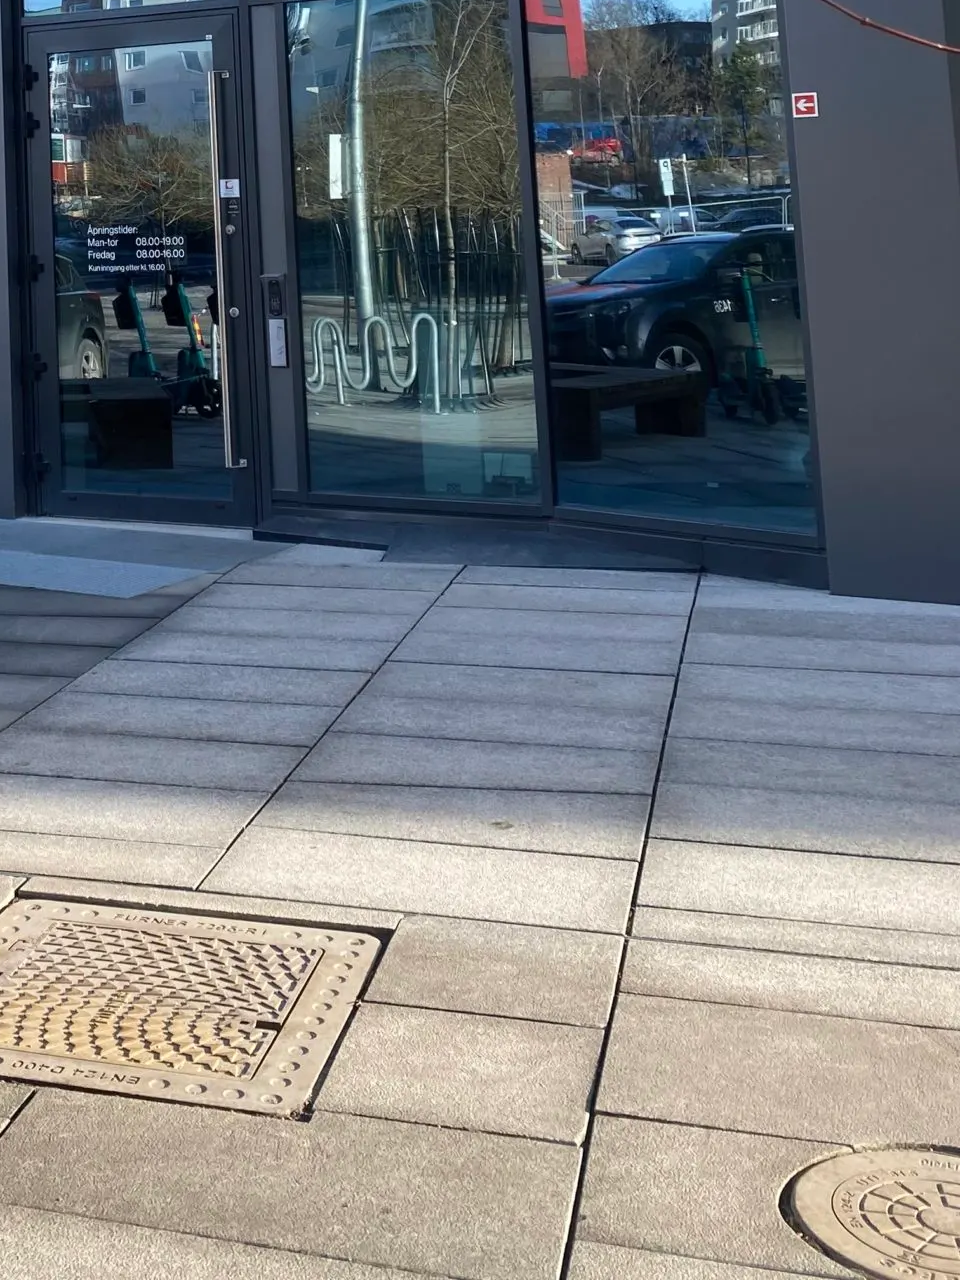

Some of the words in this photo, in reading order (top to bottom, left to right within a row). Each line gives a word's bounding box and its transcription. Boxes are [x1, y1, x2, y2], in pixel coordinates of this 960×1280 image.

[87, 223, 138, 236] Åpningstider:
[87, 238, 119, 247] Man-tor
[135, 236, 184, 246] 08.00-19.00
[87, 250, 116, 260] Fredag
[135, 249, 185, 259] 08.00-16.00
[148, 263, 166, 271] 16.00
